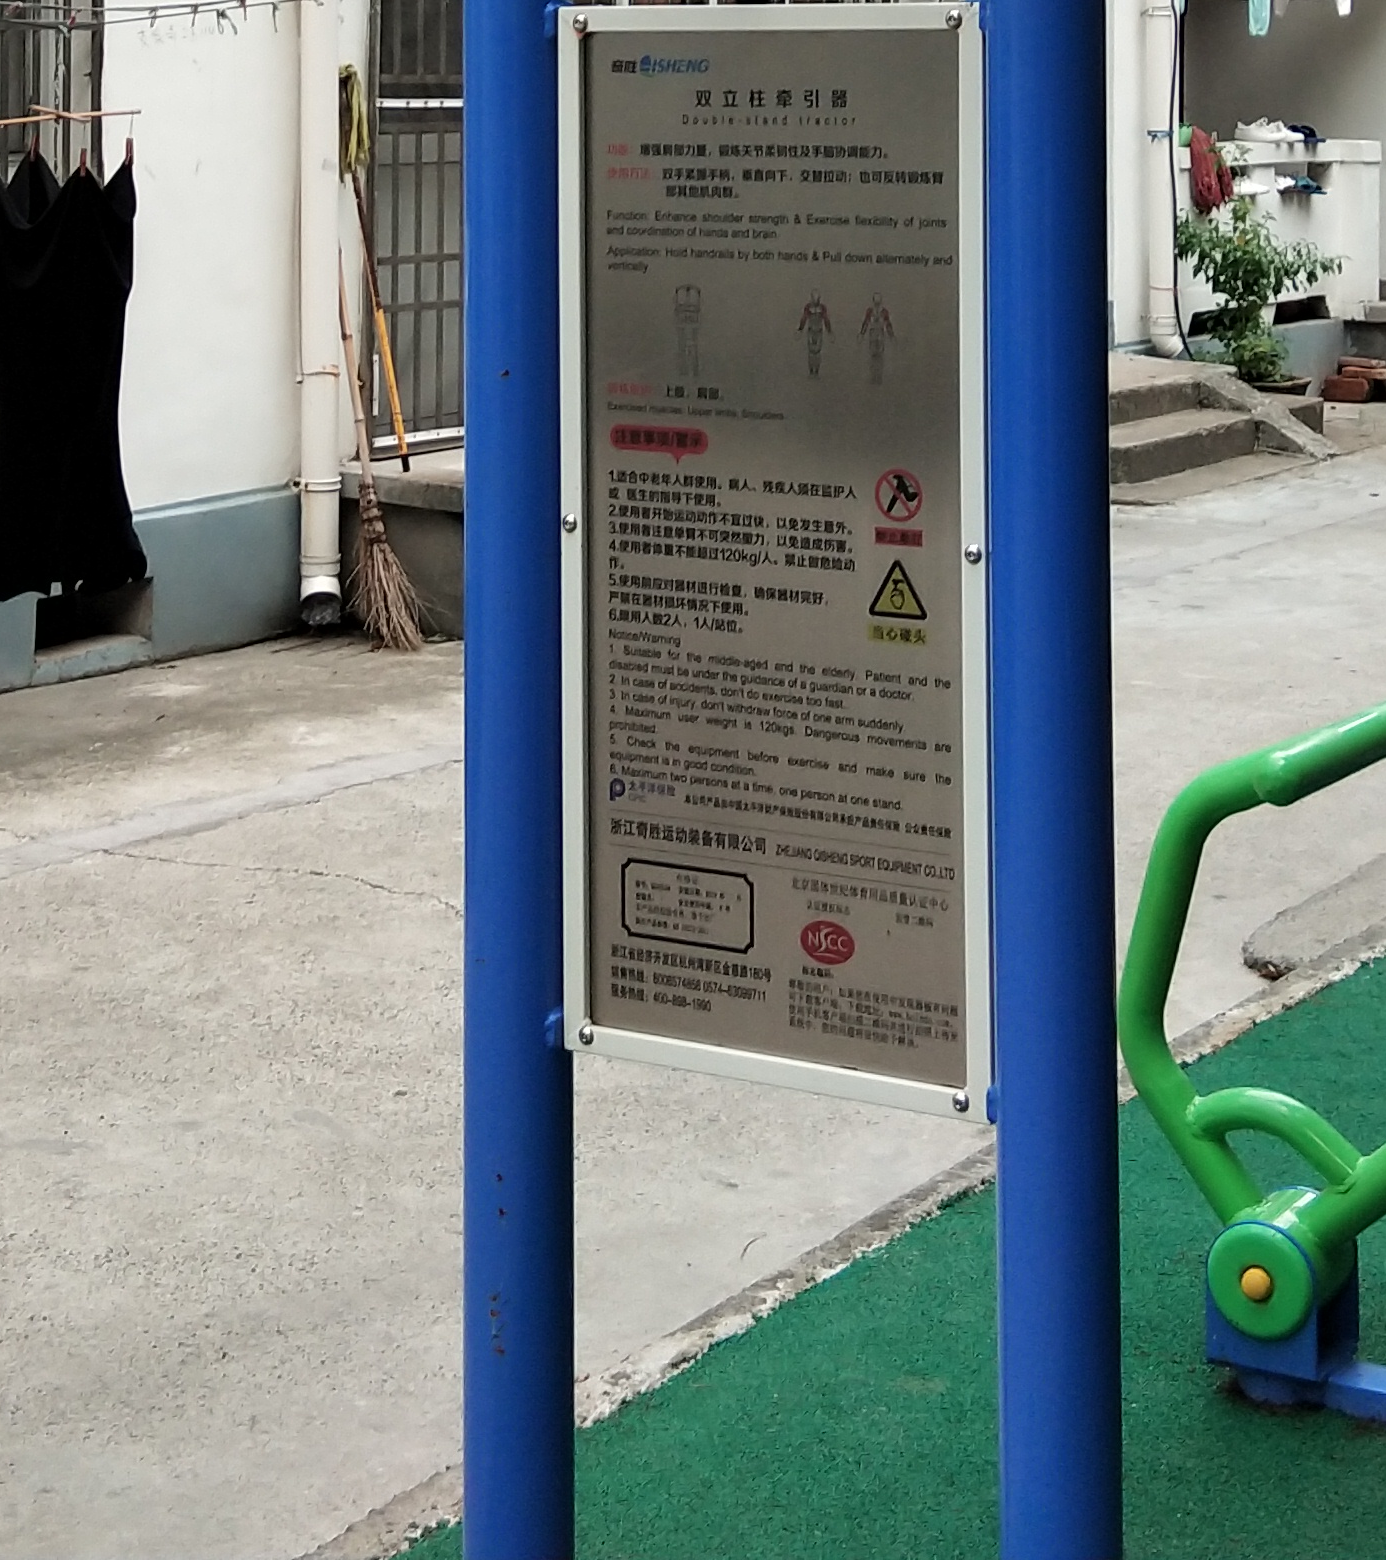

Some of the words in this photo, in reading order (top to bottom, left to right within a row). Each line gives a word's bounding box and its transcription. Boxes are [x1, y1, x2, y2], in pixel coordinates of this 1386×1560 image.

[695, 89, 848, 109] 双立柱牵引器
[903, 216, 915, 228] of
[918, 217, 948, 231] joints
[844, 251, 873, 264] down
[657, 678, 669, 690] of
[746, 688, 760, 701] do
[761, 692, 804, 705] exercise
[691, 669, 720, 680] under
[722, 670, 738, 683] the
[740, 674, 786, 688] guidance
[787, 676, 798, 689] of
[809, 680, 854, 695] guardian
[856, 686, 867, 696] or
[869, 687, 876, 698] a
[907, 675, 928, 687] and
[934, 677, 952, 689] the
[657, 693, 669, 705] of
[772, 706, 799, 720] force
[800, 710, 811, 721] of
[813, 712, 832, 724] one
[834, 715, 855, 726] arm
[804, 725, 861, 742] Dangerous
[866, 734, 928, 751] movements
[934, 742, 952, 754] are
[626, 734, 657, 749] Check
[688, 744, 740, 760] equipment
[747, 749, 780, 764] before
[787, 757, 830, 771] exercise
[838, 761, 858, 774] and
[865, 765, 895, 779] make
[903, 769, 927, 783] sure
[934, 772, 952, 786] the
[683, 759, 709, 772] good
[669, 771, 688, 783] two
[689, 775, 729, 789] persons
[850, 795, 870, 807] one
[610, 818, 767, 856] 浙江奇胜运动装备有限公司
[849, 853, 876, 870] SPORT
[807, 924, 848, 953] NSCC
